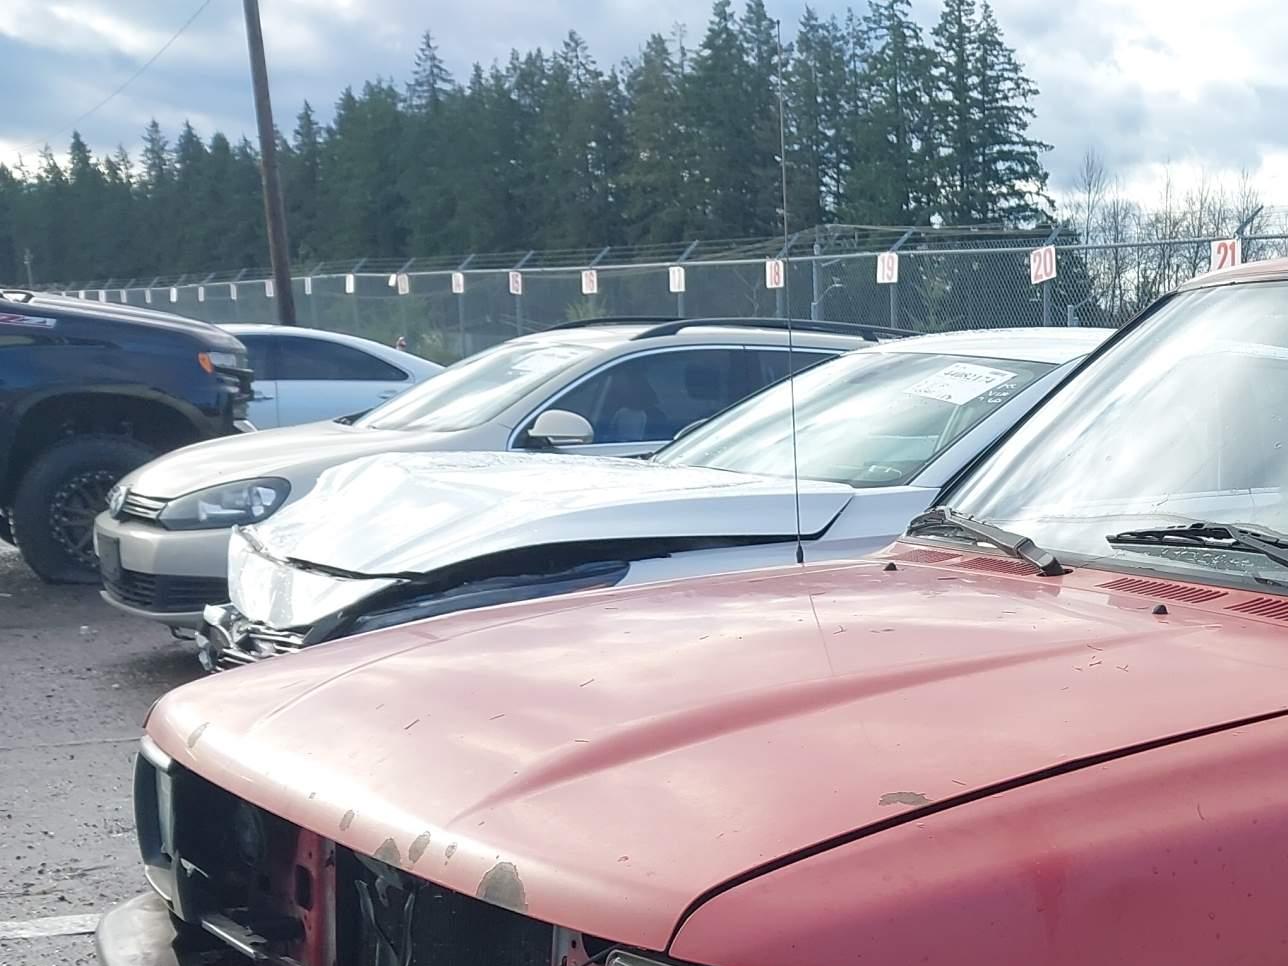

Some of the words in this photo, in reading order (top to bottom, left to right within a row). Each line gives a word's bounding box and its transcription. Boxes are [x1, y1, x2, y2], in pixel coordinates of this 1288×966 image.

[880, 254, 895, 282] 19
[1033, 247, 1054, 281] 20
[1216, 241, 1237, 270] 21
[770, 261, 781, 287] 18
